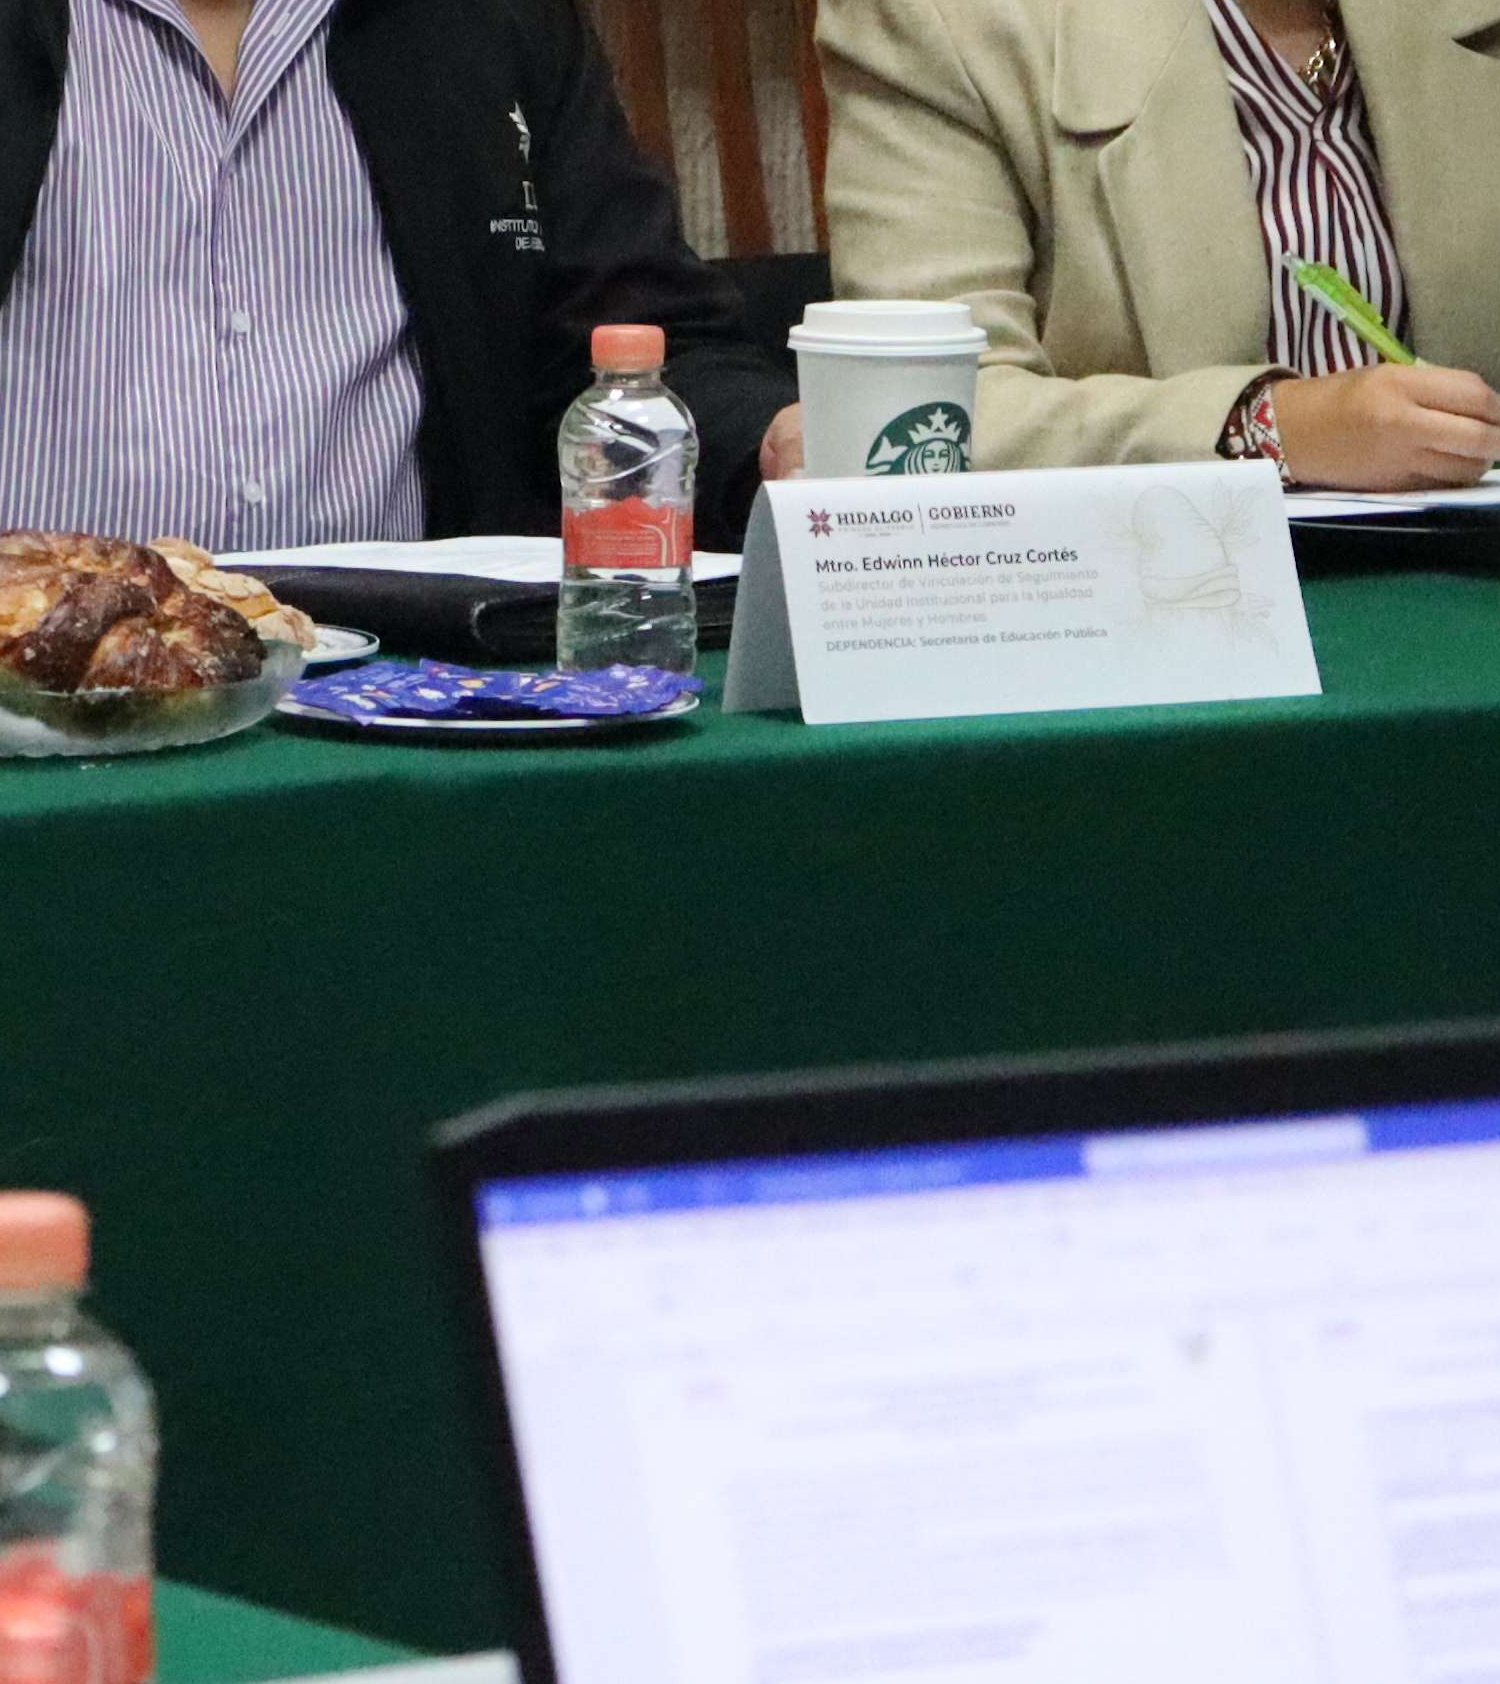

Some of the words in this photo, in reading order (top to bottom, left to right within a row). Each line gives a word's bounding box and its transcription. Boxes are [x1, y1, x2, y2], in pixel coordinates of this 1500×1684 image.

[835, 510, 914, 526] HIDALGO
[927, 504, 1017, 521] GOBIERNO
[815, 558, 859, 575] Mtro.
[985, 549, 1022, 566] Cruz
[1025, 546, 1078, 564] Cortés
[898, 575, 915, 590] de
[996, 571, 1014, 586] de
[820, 599, 837, 614] de
[840, 600, 853, 612] la
[989, 591, 1019, 605] para
[1021, 589, 1034, 603] la
[822, 617, 859, 631] entre
[981, 632, 997, 645] de
